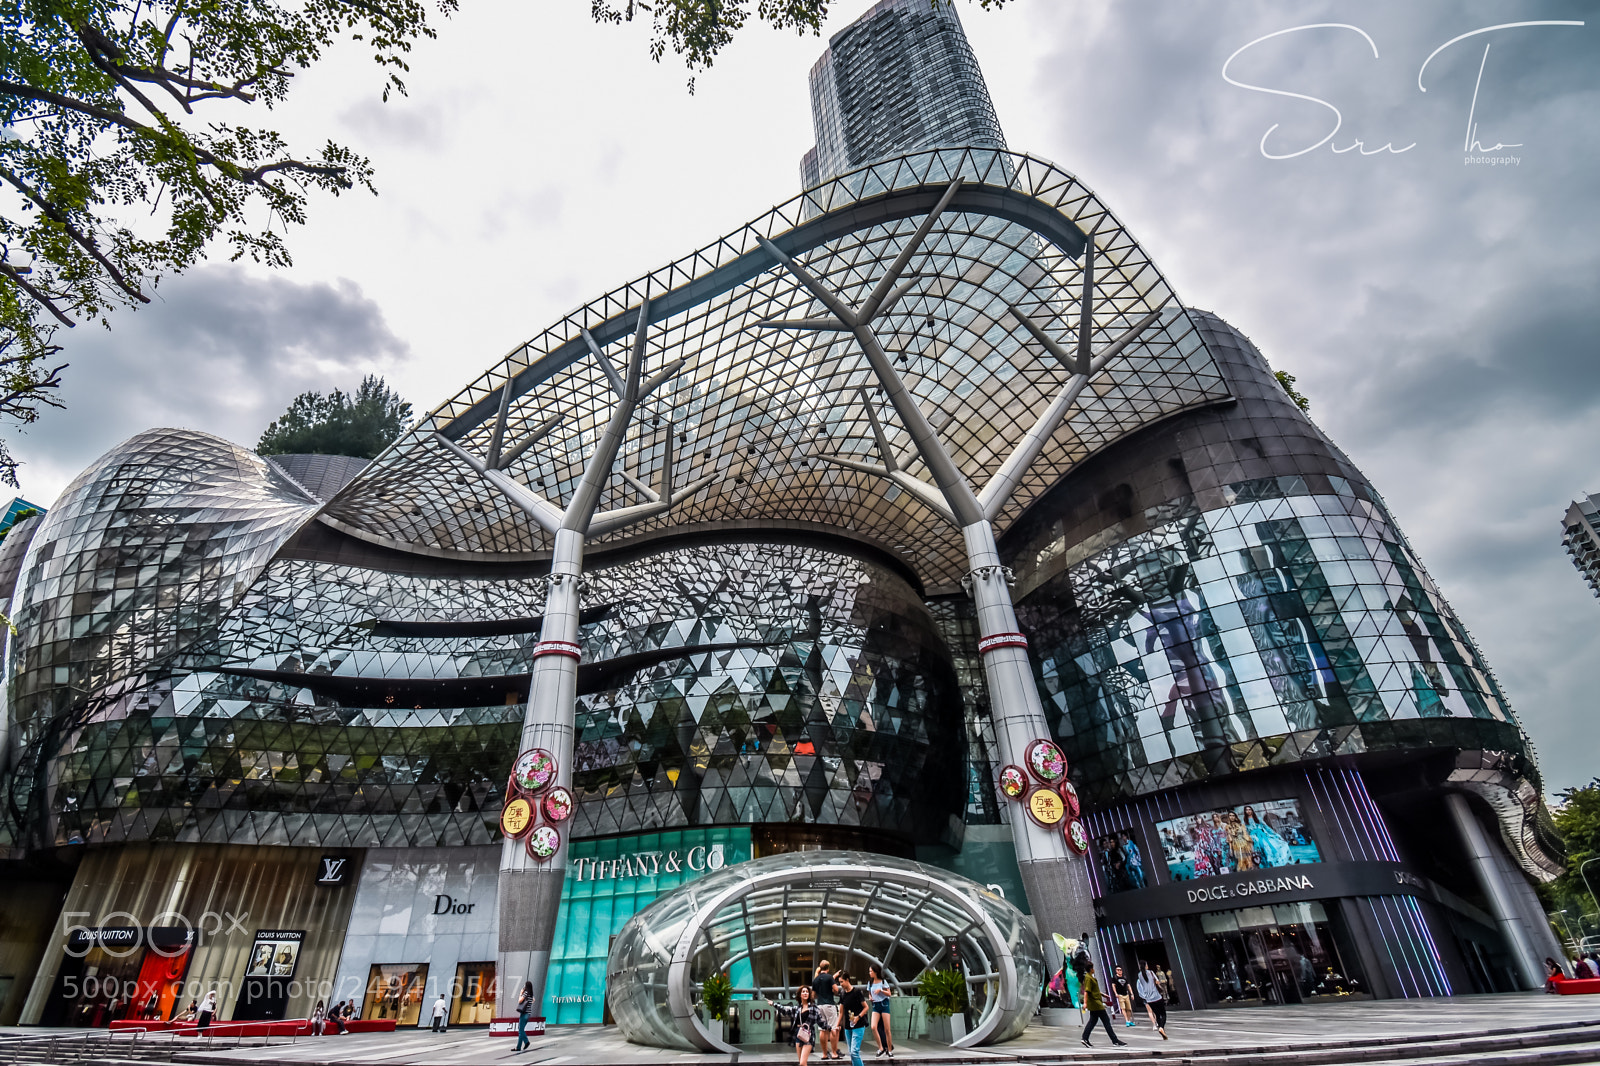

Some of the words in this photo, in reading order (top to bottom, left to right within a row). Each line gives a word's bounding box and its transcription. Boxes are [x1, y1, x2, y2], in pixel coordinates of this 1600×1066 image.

[573, 853, 664, 882] TIFFANY
[665, 850, 684, 873] &
[1187, 885, 1229, 903] DOLCE
[1236, 875, 1314, 897] GABBANA
[432, 894, 475, 915] Dior
[79, 930, 98, 940] LOUIS
[99, 930, 134, 940] VUITTON
[552, 995, 576, 1003] TIFFANY
